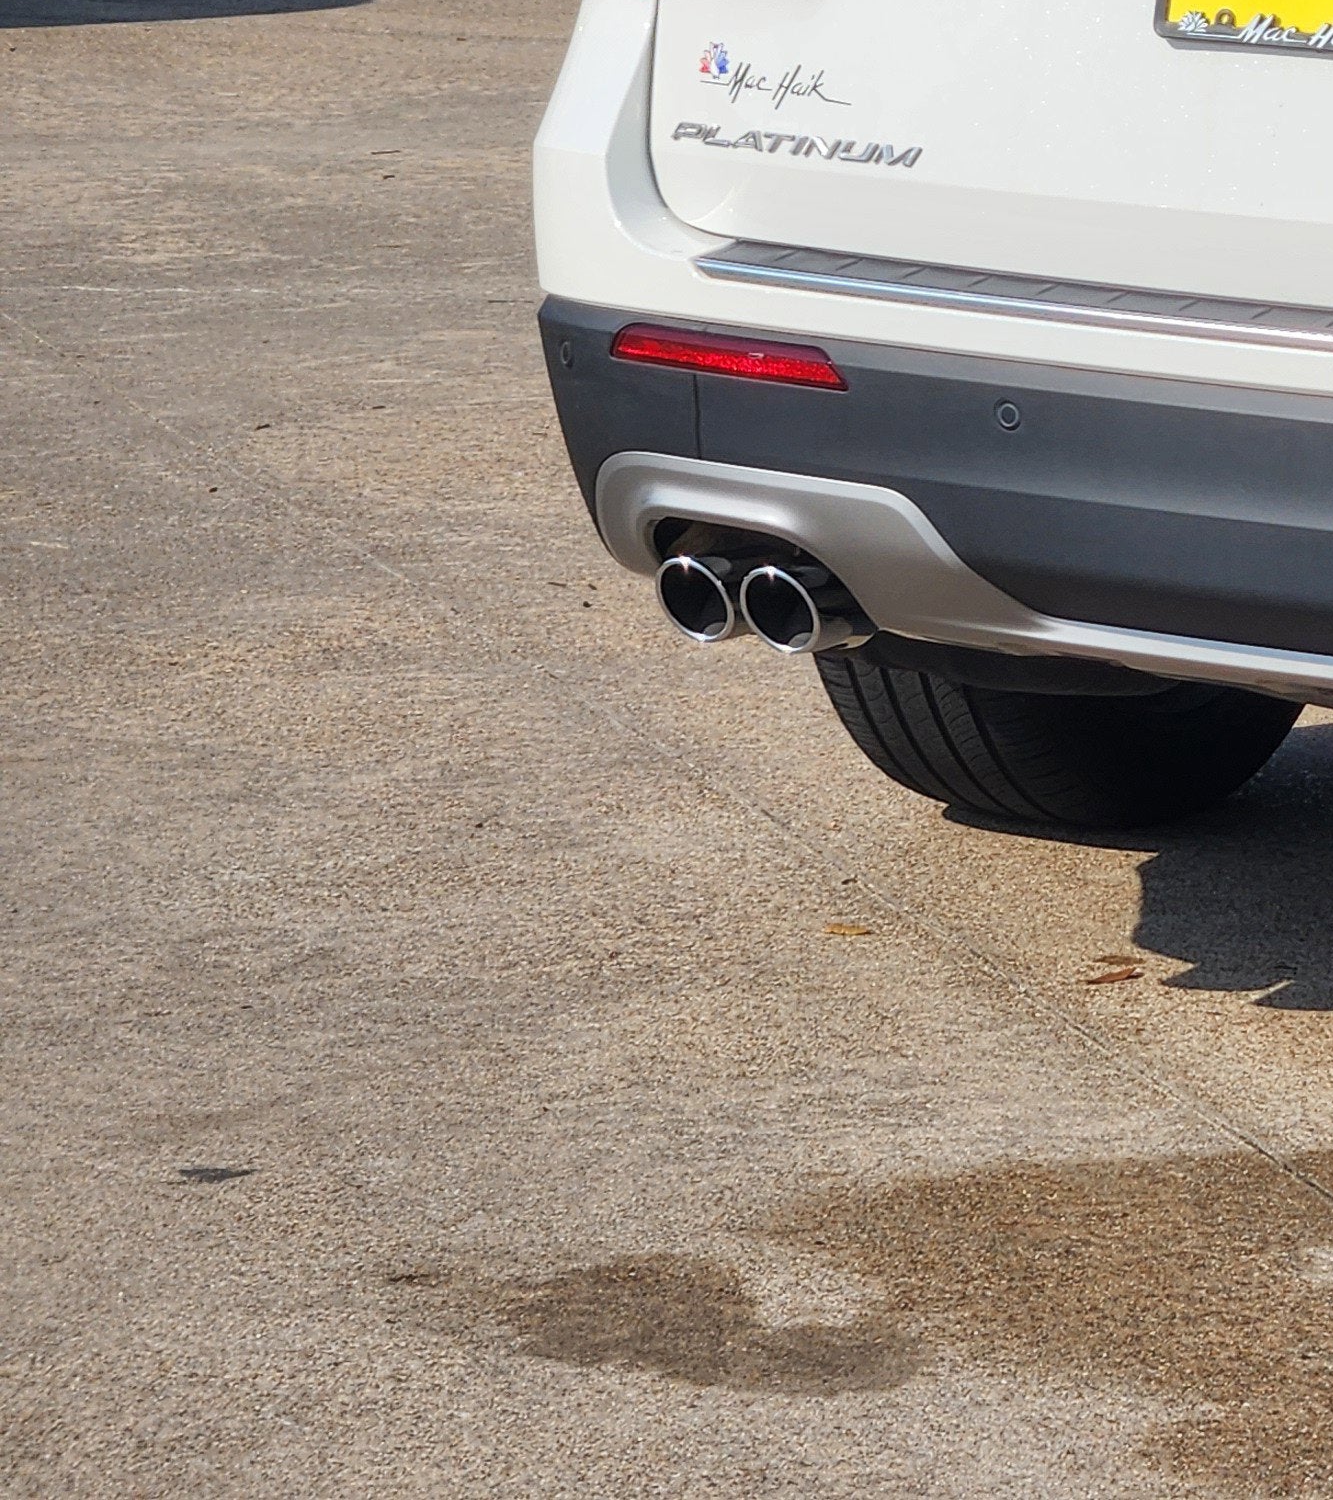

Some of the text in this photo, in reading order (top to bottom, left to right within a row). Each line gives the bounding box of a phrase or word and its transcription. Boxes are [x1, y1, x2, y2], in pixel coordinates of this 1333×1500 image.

[1236, 13, 1306, 43] Mac
[726, 62, 840, 110] Mac Haik
[670, 121, 923, 169] PLATINUM
